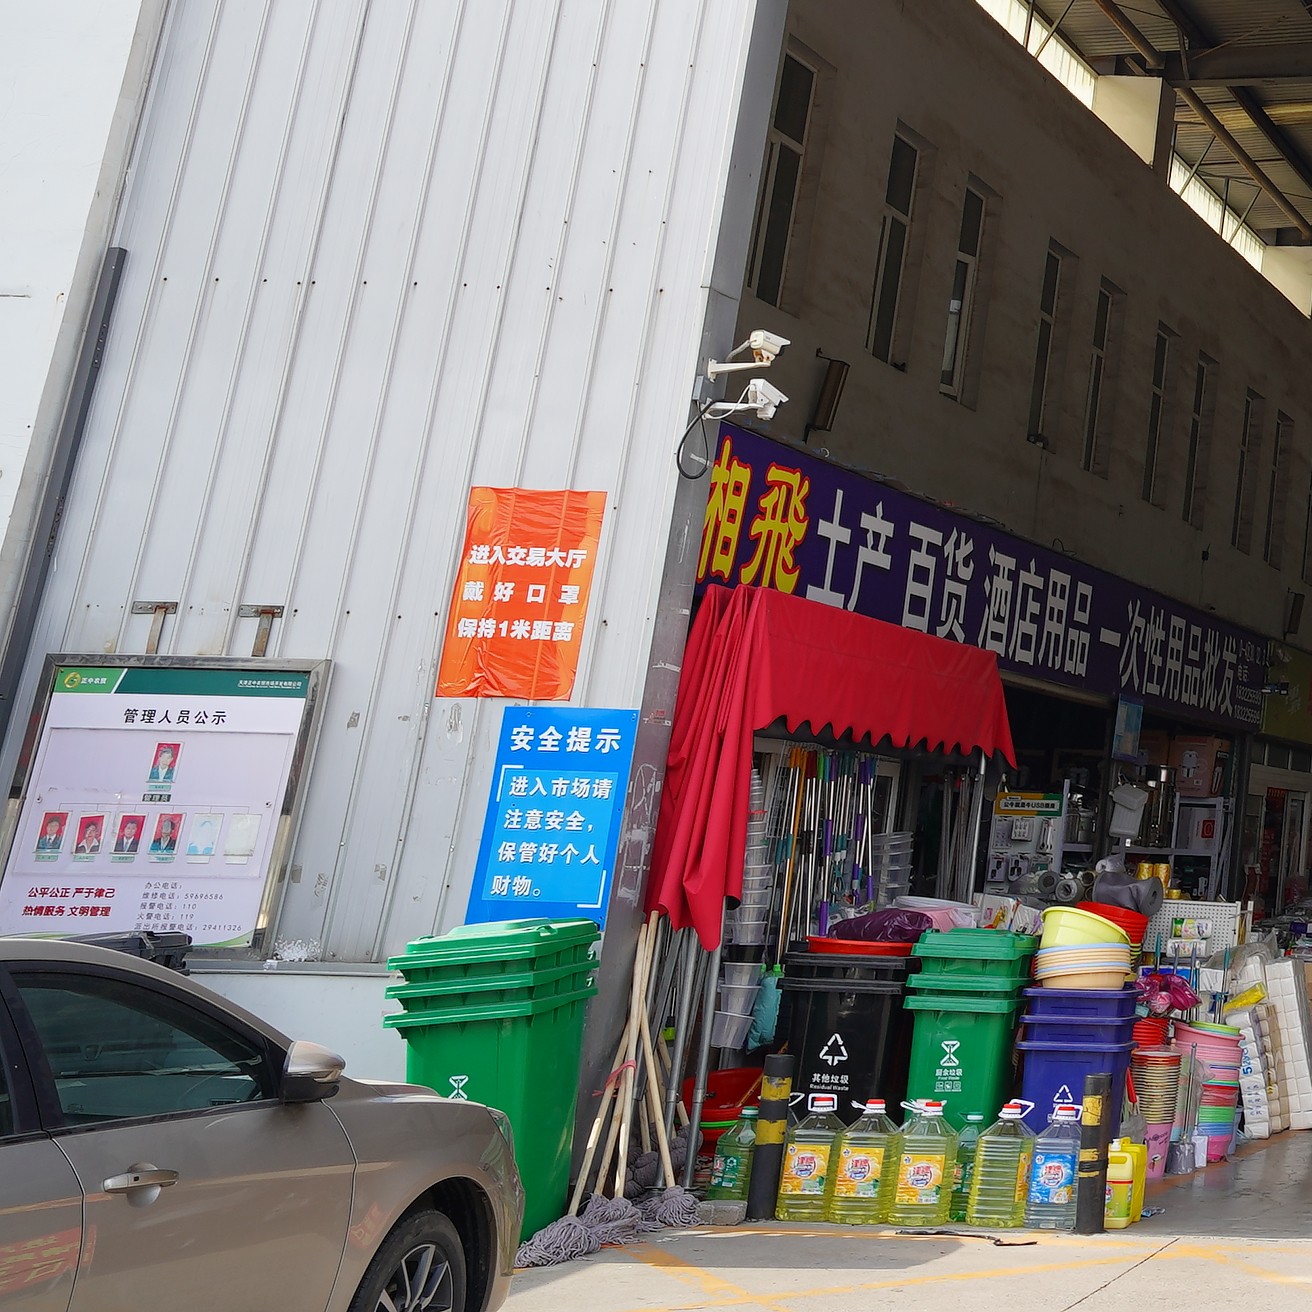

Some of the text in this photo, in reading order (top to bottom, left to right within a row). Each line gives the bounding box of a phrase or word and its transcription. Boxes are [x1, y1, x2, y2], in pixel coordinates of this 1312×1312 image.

[468, 545, 587, 569] 进入交易大厅
[462, 581, 581, 605] 戴好口罩
[457, 618, 575, 641] 保持1米距离
[124, 708, 227, 725] 管理人员公示
[510, 725, 622, 754] 安全提示
[508, 776, 613, 799] 进入市场请
[504, 809, 595, 832] 注意安全，
[498, 841, 600, 866] 保管好个人
[27, 887, 116, 899] 公平公正 严于律己
[490, 876, 543, 898] 财物。
[21, 905, 111, 917] 热情服务 文明管理
[811, 1072, 849, 1085] 其他垃圾
